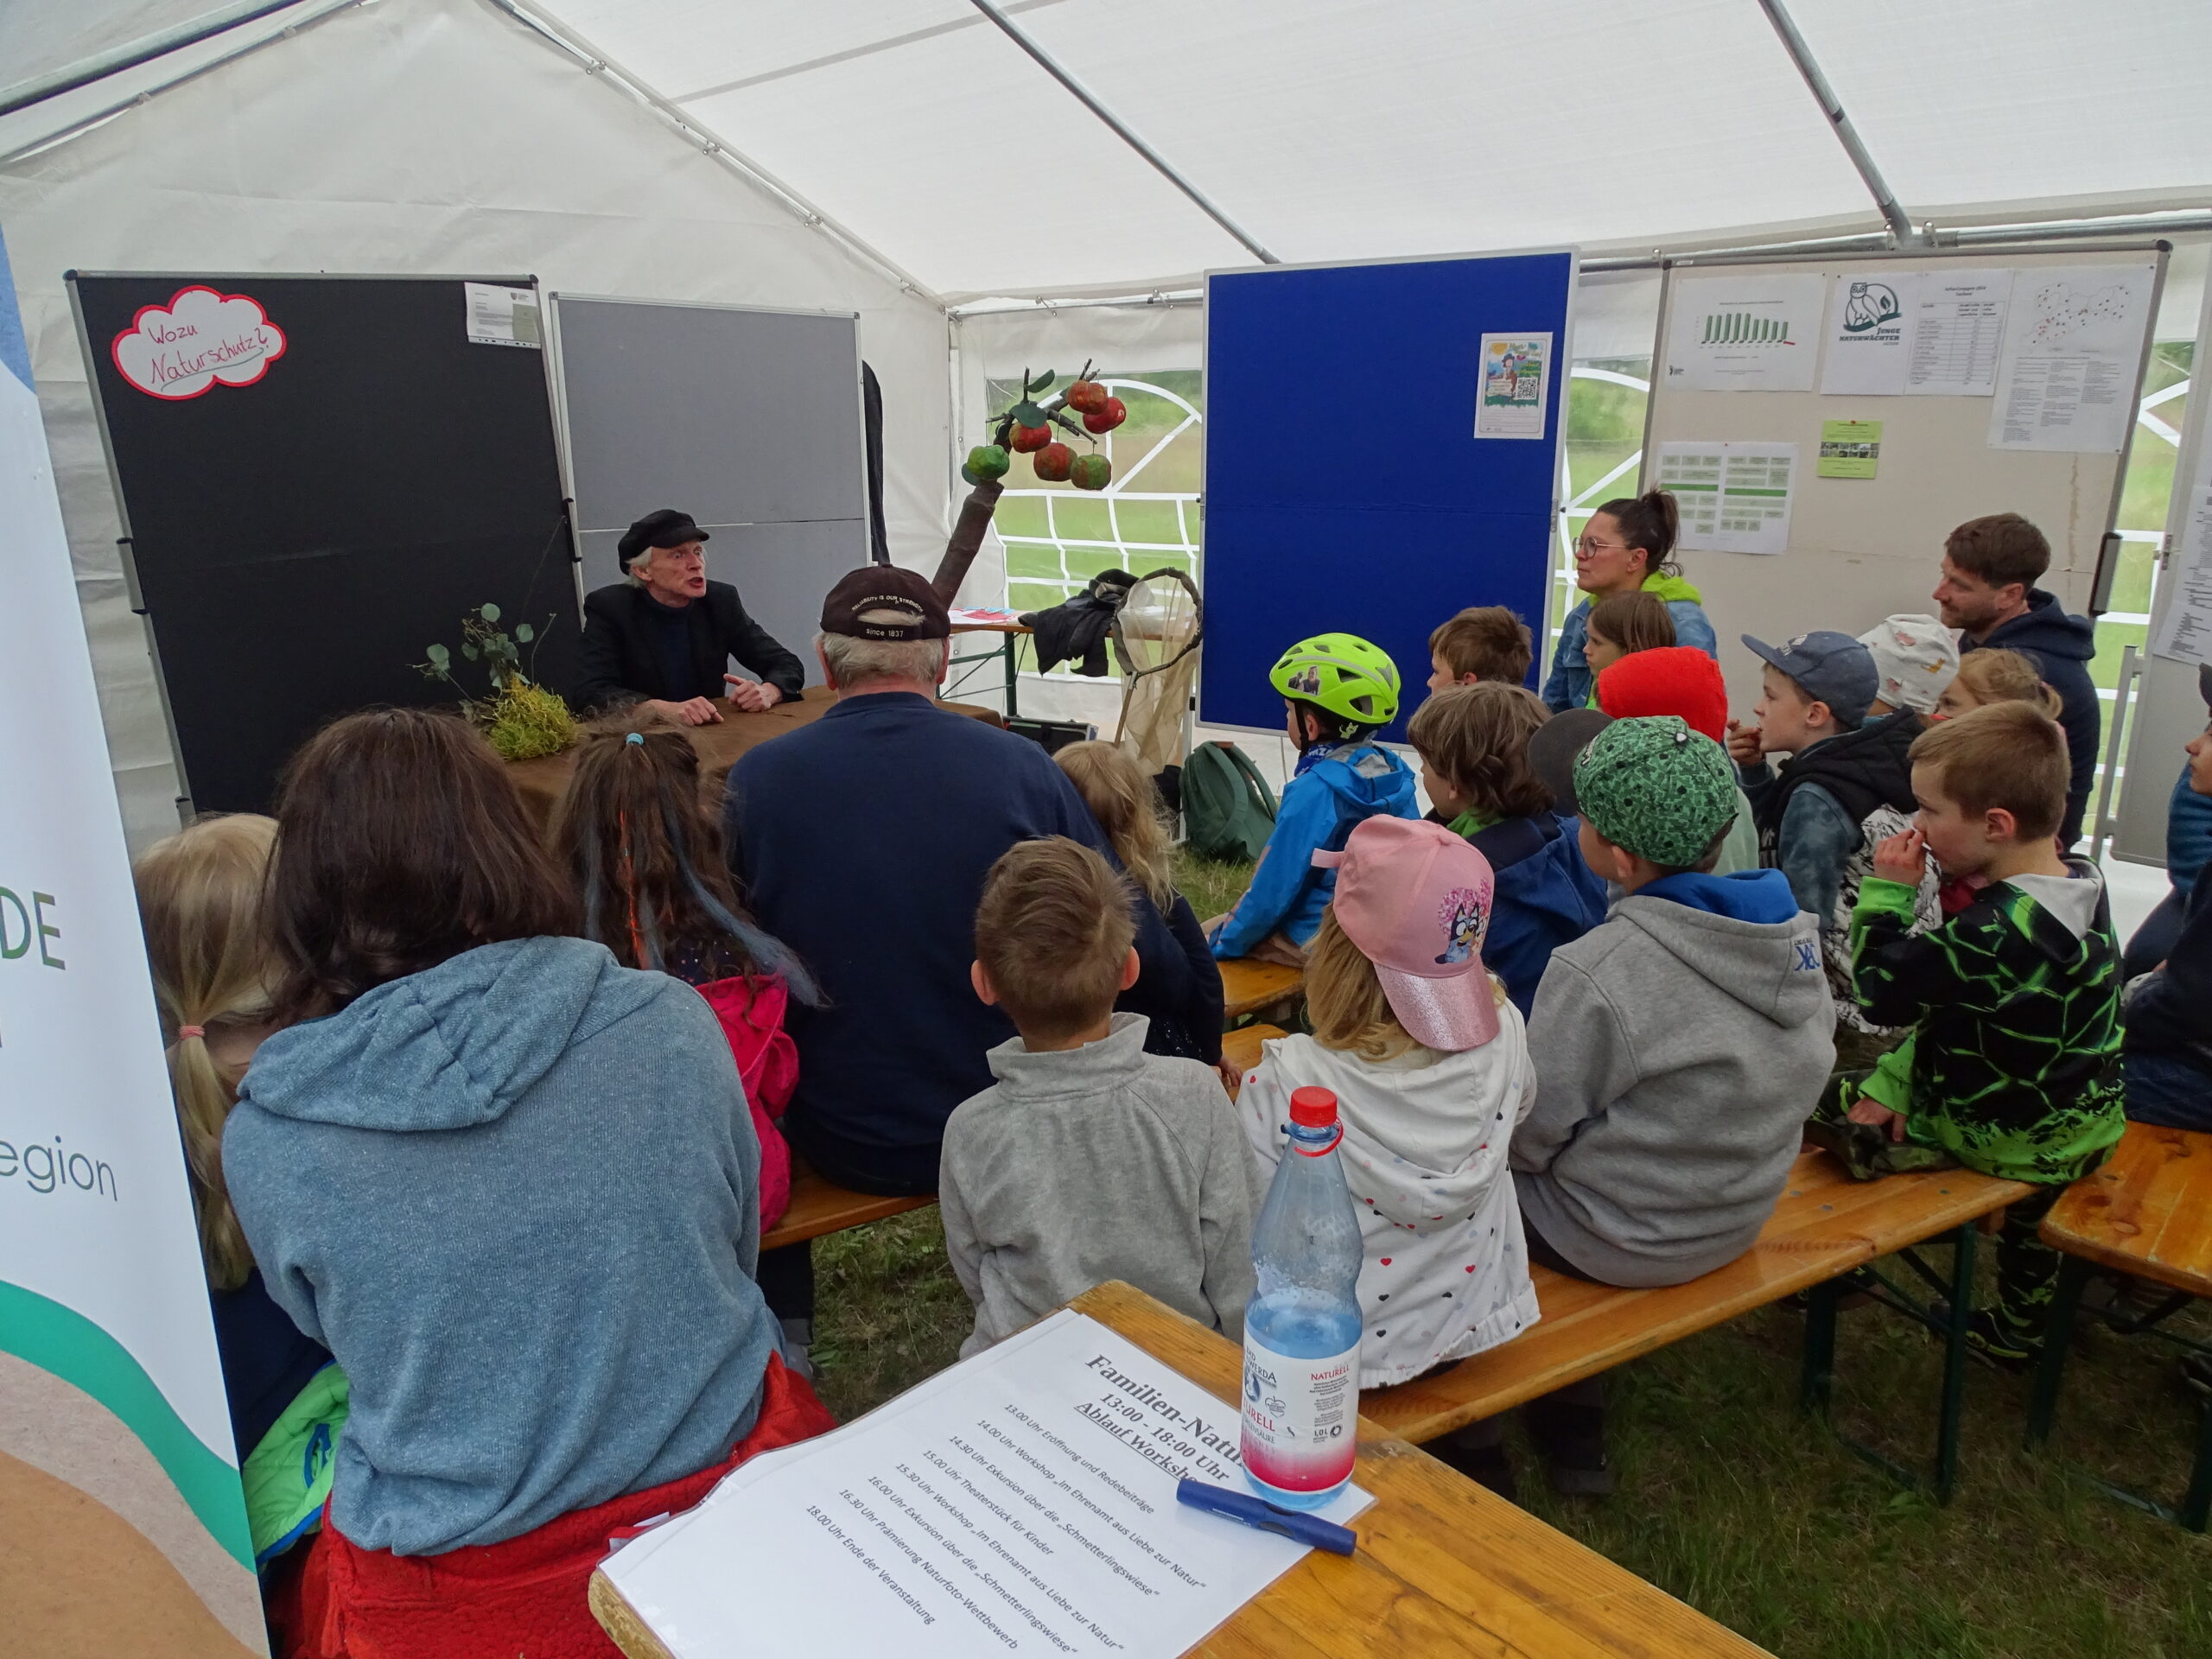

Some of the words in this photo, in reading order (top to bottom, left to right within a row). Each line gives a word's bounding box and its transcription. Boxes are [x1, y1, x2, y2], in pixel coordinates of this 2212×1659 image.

[148, 324, 198, 344] Wozu
[151, 327, 269, 385] Naturschutz?
[0, 1135, 118, 1201] egion
[1085, 1354, 1242, 1468] Familien-Natu
[1311, 1364, 1350, 1381] NATURELL
[1004, 1404, 1028, 1423] 13.00
[1027, 1418, 1044, 1433] Uhr
[1042, 1429, 1082, 1463] Eröffnung
[1082, 1458, 1100, 1473] und
[1099, 1471, 1154, 1515] Redebeiträge
[1077, 1401, 1134, 1442] Ablauf
[1100, 1392, 1143, 1422] 13:00
[1150, 1426, 1196, 1457] 18:00
[1196, 1454, 1230, 1482] Uhr
[868, 1476, 893, 1497] 16.00
[889, 1493, 907, 1509] Uhr
[905, 1507, 944, 1541] Exkursion
[942, 1538, 964, 1558] über
[962, 1556, 978, 1571] die
[922, 1450, 948, 1469] 15.00
[944, 1466, 962, 1481] Uhr
[961, 1478, 1012, 1523] Theaterstück
[1010, 1520, 1026, 1534] für
[1023, 1530, 1054, 1555] Kinder
[950, 1435, 974, 1455] 14.30
[971, 1452, 988, 1466] Uhr
[986, 1464, 1024, 1496] Exkursion
[1024, 1492, 1046, 1511] über
[1044, 1508, 1059, 1522] die
[977, 1420, 1001, 1438] 14.00
[1000, 1435, 1016, 1449] Uhr
[1015, 1446, 1055, 1481] Workshop
[1071, 1489, 1113, 1523] Ehrenamt
[1112, 1520, 1129, 1535] aus
[1128, 1533, 1154, 1554] Liebe
[1154, 1553, 1172, 1566] zur
[806, 1505, 831, 1527] 18.00
[828, 1523, 846, 1541] Uhr
[842, 1538, 865, 1559] Ende
[863, 1556, 880, 1572] der
[878, 1569, 936, 1625] Veranstaltung
[839, 1489, 864, 1510] 16.30
[861, 1507, 879, 1523] Uhr
[875, 1521, 922, 1564] Prämierung
[921, 1561, 1018, 1649] Naturfoto-Wettbewerb
[895, 1463, 920, 1483] 15.30
[918, 1480, 935, 1496] Uhr
[933, 1493, 974, 1529] Workshop
[988, 1540, 1032, 1577] Ehrenamt
[1030, 1574, 1047, 1591] aus
[1046, 1588, 1072, 1611] Liebe
[1071, 1610, 1089, 1624] zur
